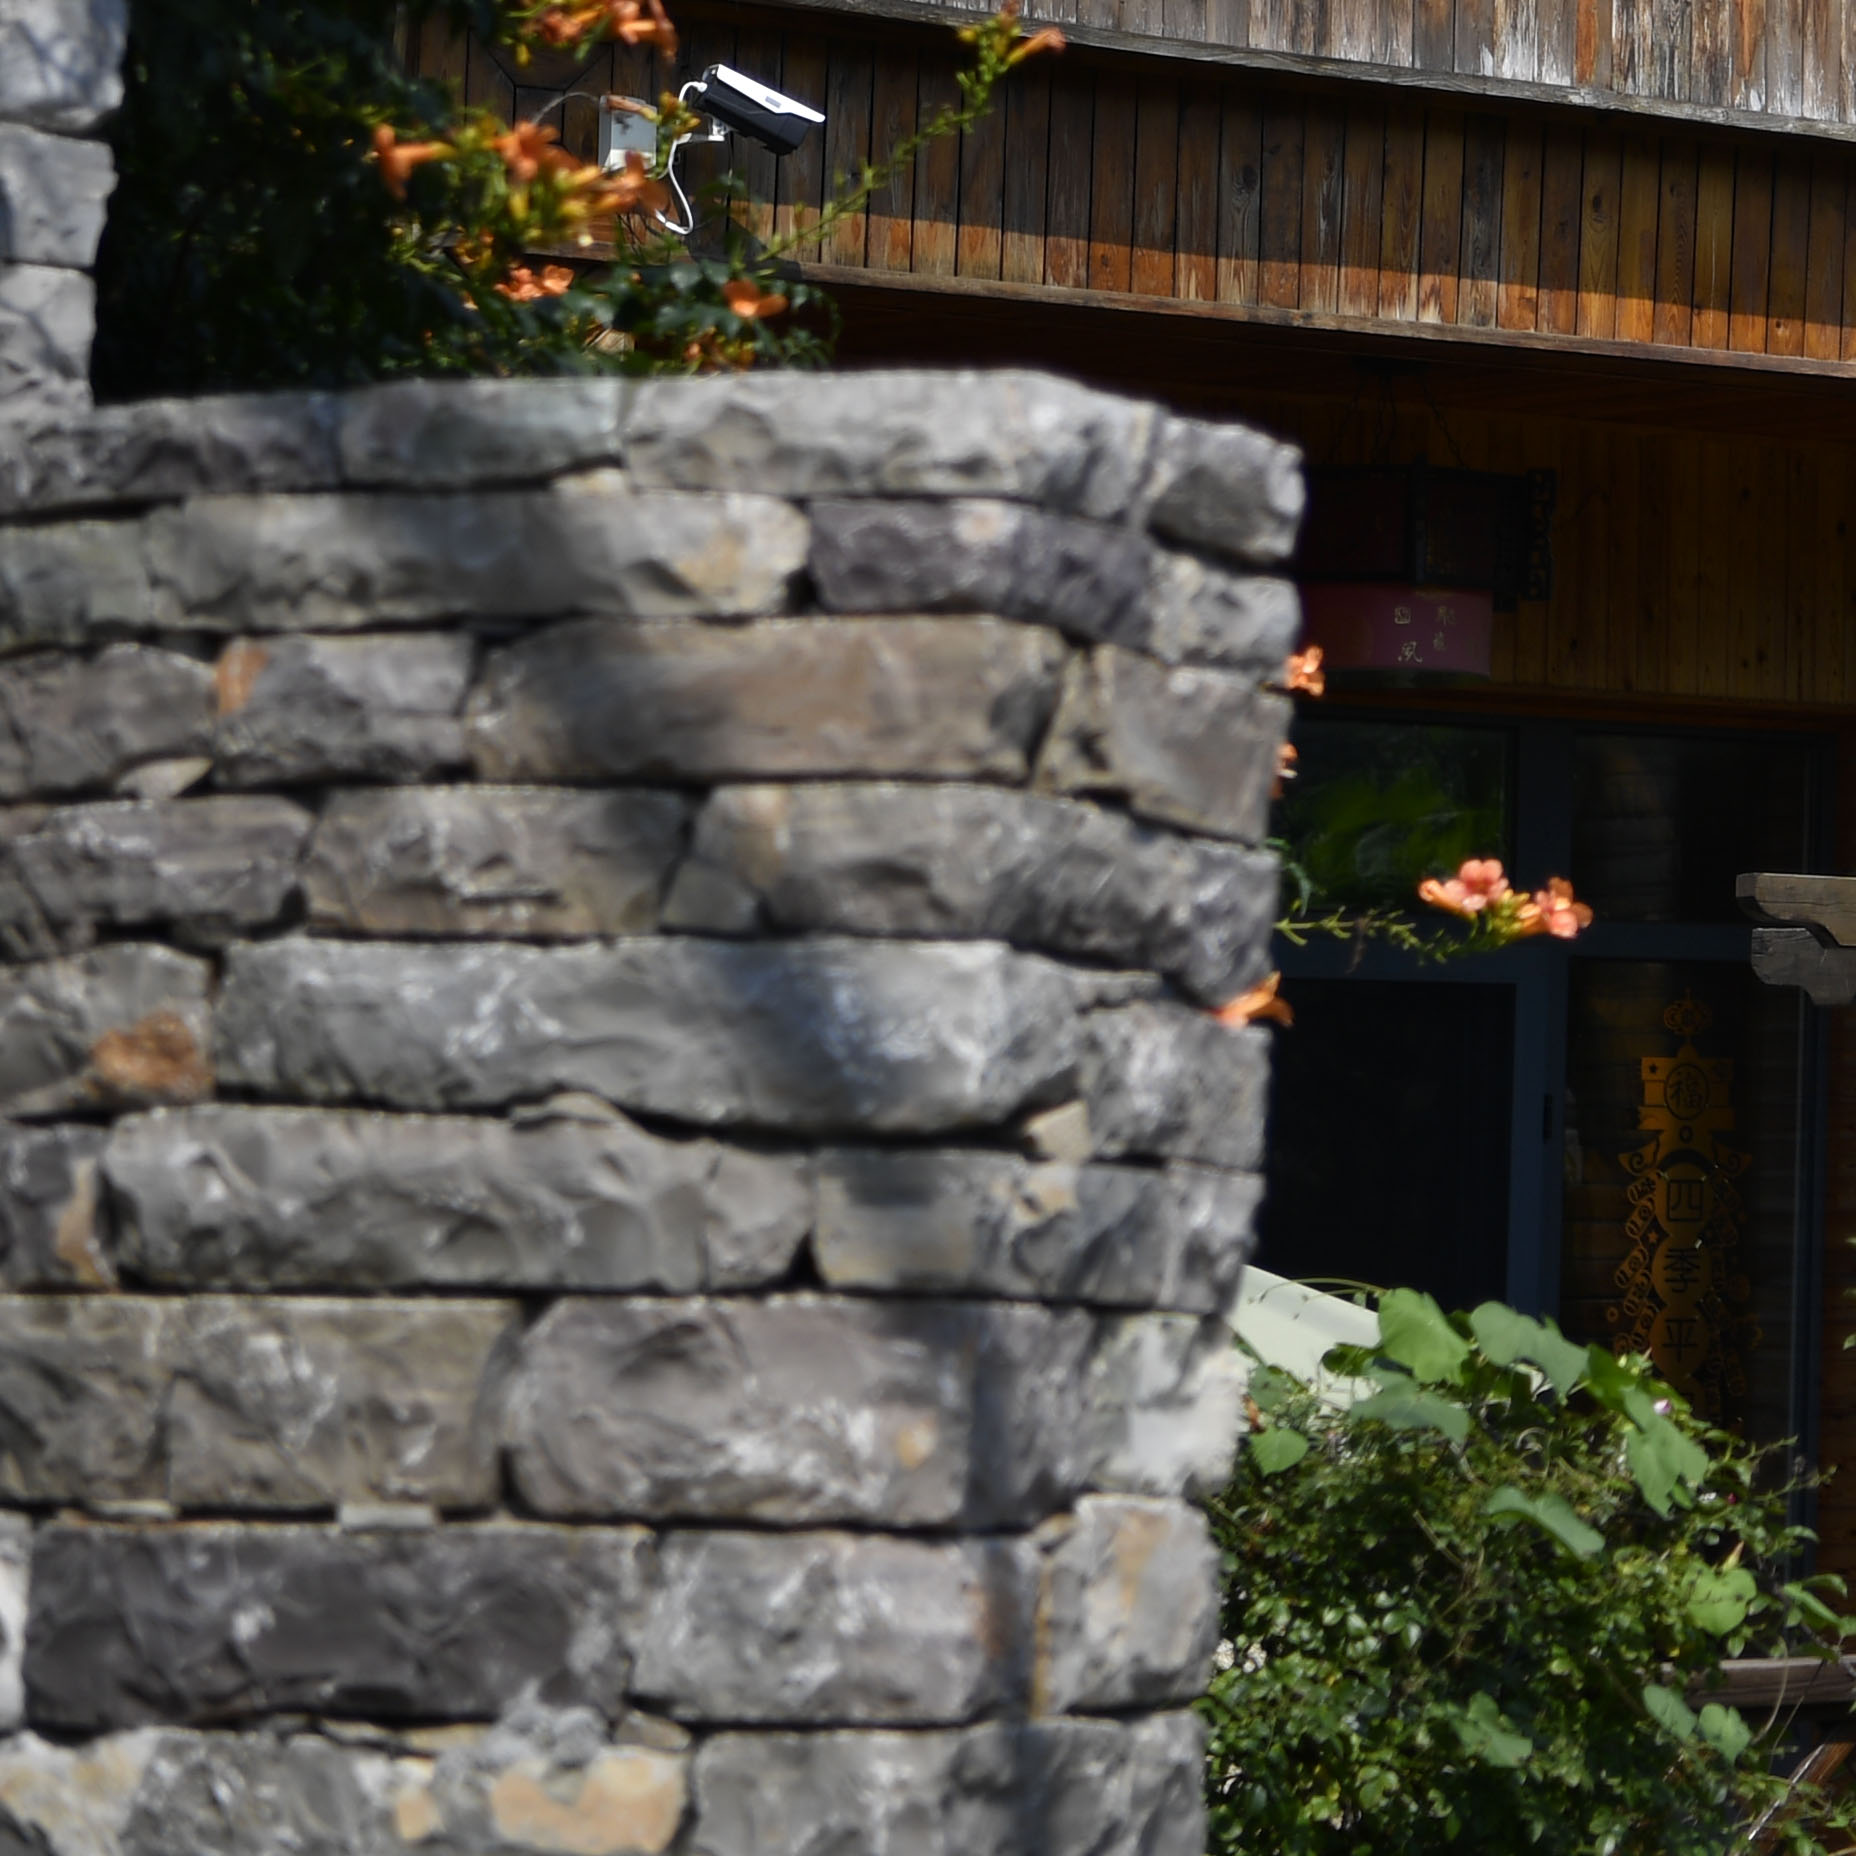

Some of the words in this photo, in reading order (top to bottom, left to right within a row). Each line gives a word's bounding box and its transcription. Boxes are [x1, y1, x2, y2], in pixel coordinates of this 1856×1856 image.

[1668, 1070, 1704, 1111] 福
[1662, 1178, 1705, 1400] 四季平
